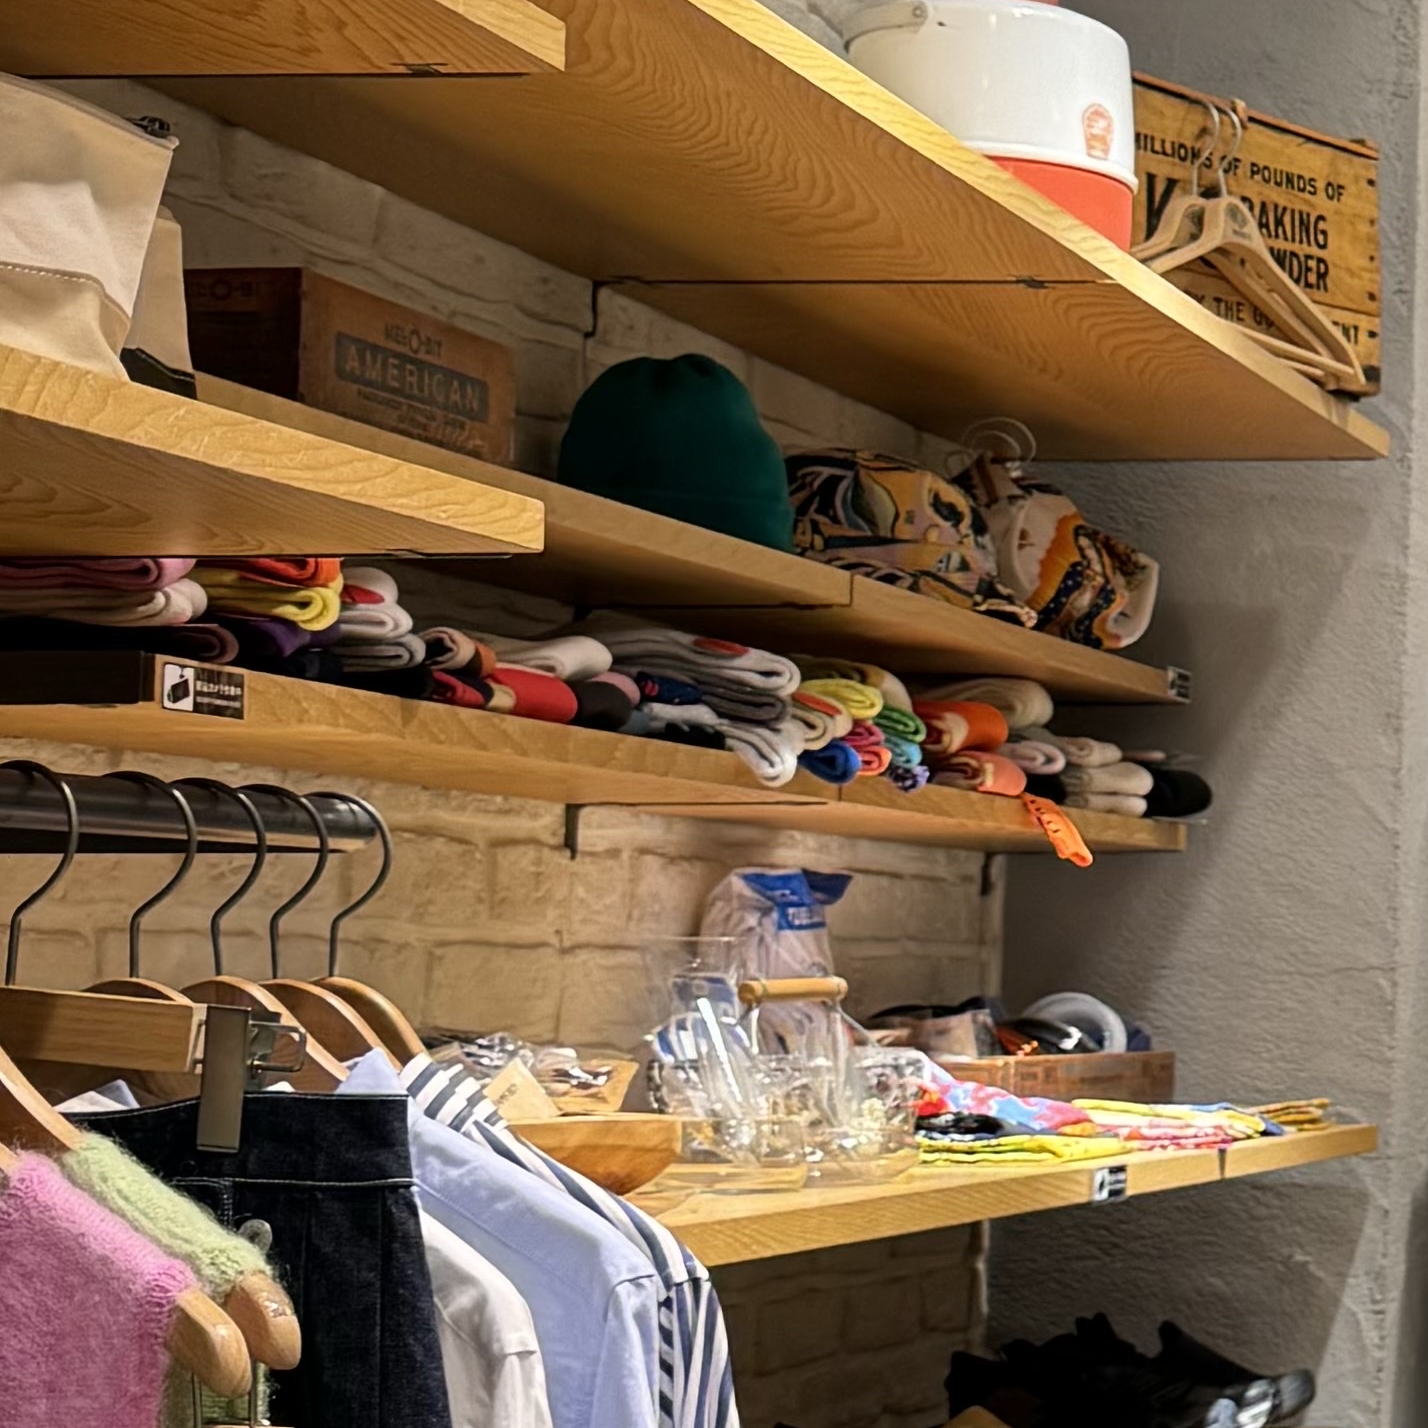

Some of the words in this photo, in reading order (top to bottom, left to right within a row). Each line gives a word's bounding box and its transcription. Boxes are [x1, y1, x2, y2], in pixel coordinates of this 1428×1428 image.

[1221, 155, 1242, 176] OF
[1250, 162, 1317, 196] POUNDS
[1325, 181, 1346, 203] OF
[1213, 296, 1245, 322] THE
[346, 344, 478, 413] AMERICAN
